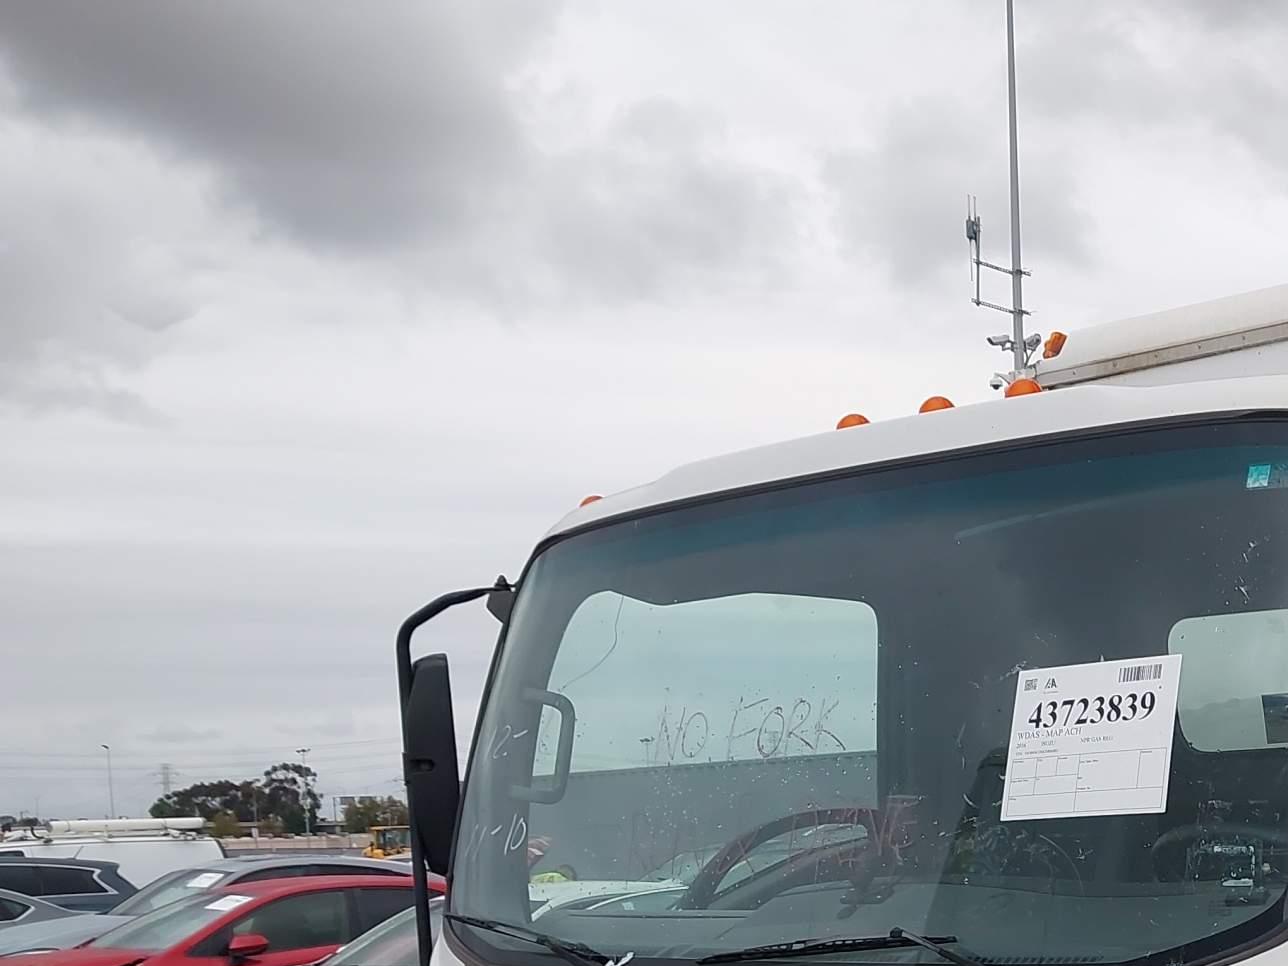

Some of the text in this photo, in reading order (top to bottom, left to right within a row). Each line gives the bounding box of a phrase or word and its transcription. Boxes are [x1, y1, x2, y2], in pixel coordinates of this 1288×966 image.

[655, 697, 846, 760] NO FORK
[1028, 691, 1156, 729] 43723839
